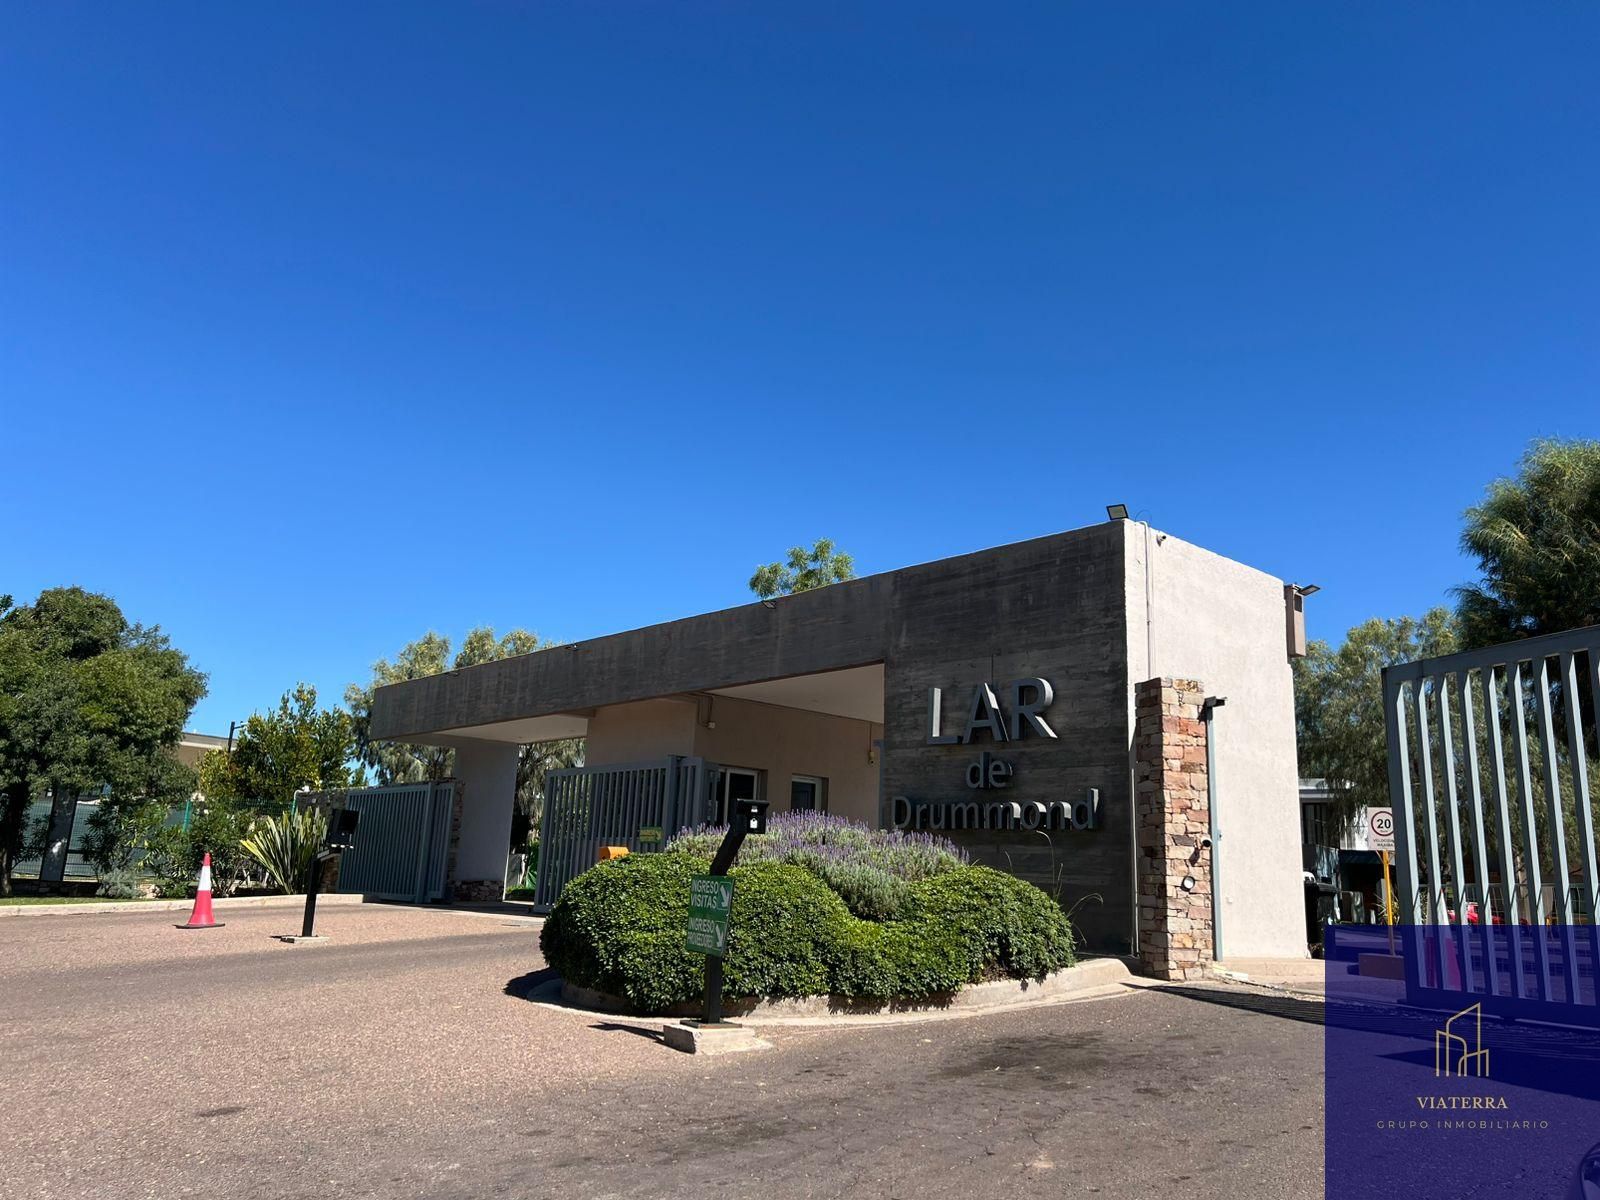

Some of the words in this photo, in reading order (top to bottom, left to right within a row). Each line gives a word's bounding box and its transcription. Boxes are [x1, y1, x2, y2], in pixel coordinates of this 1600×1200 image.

[927, 677, 1058, 745] LAR
[965, 751, 1014, 789] de
[891, 787, 1100, 831] Drummond
[1377, 819, 1391, 828] 20
[691, 879, 719, 894] INGRESO
[690, 893, 718, 909] VISITAS
[688, 917, 715, 934] INGRESO
